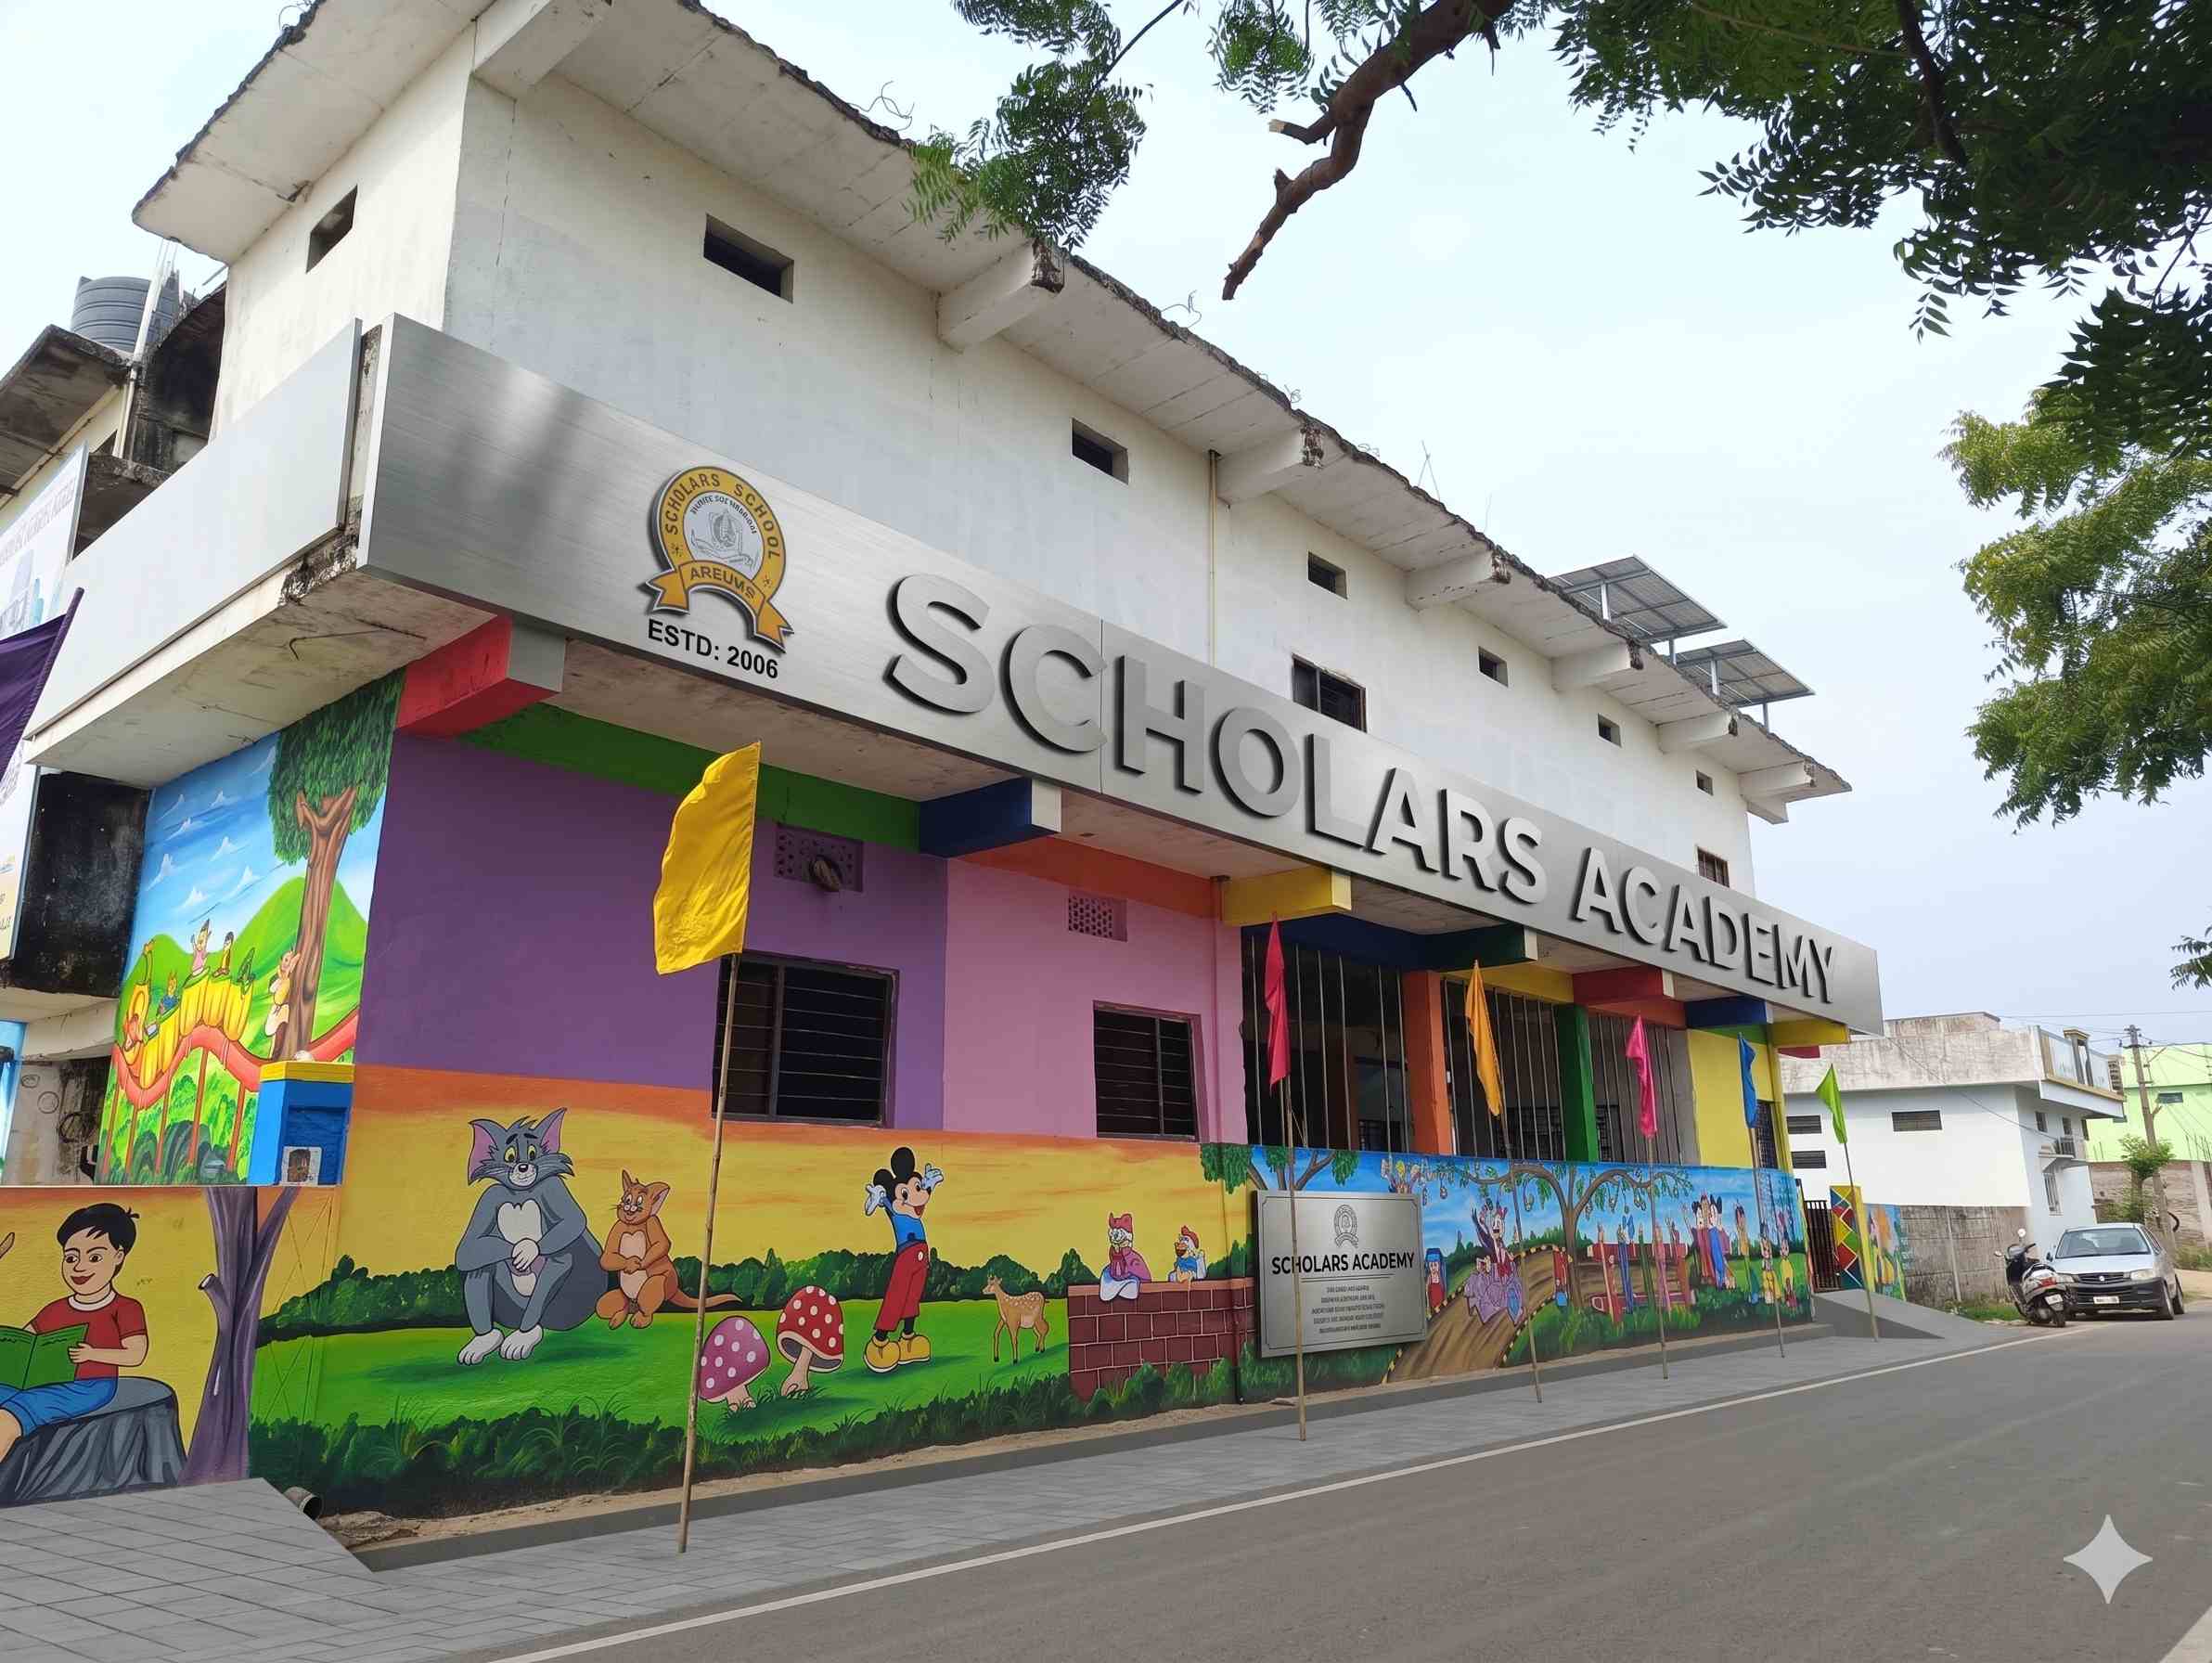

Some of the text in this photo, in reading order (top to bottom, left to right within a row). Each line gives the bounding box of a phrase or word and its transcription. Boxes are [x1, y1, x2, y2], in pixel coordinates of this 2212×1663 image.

[665, 473, 721, 535] SCHOLARS
[733, 483, 780, 560] SCHOOL
[648, 618, 778, 679] ESTD: 2006
[884, 573, 1833, 1004] SCHOLARS ACADEMY
[1271, 1252, 1415, 1275] SCHOLARS ACADEMY
